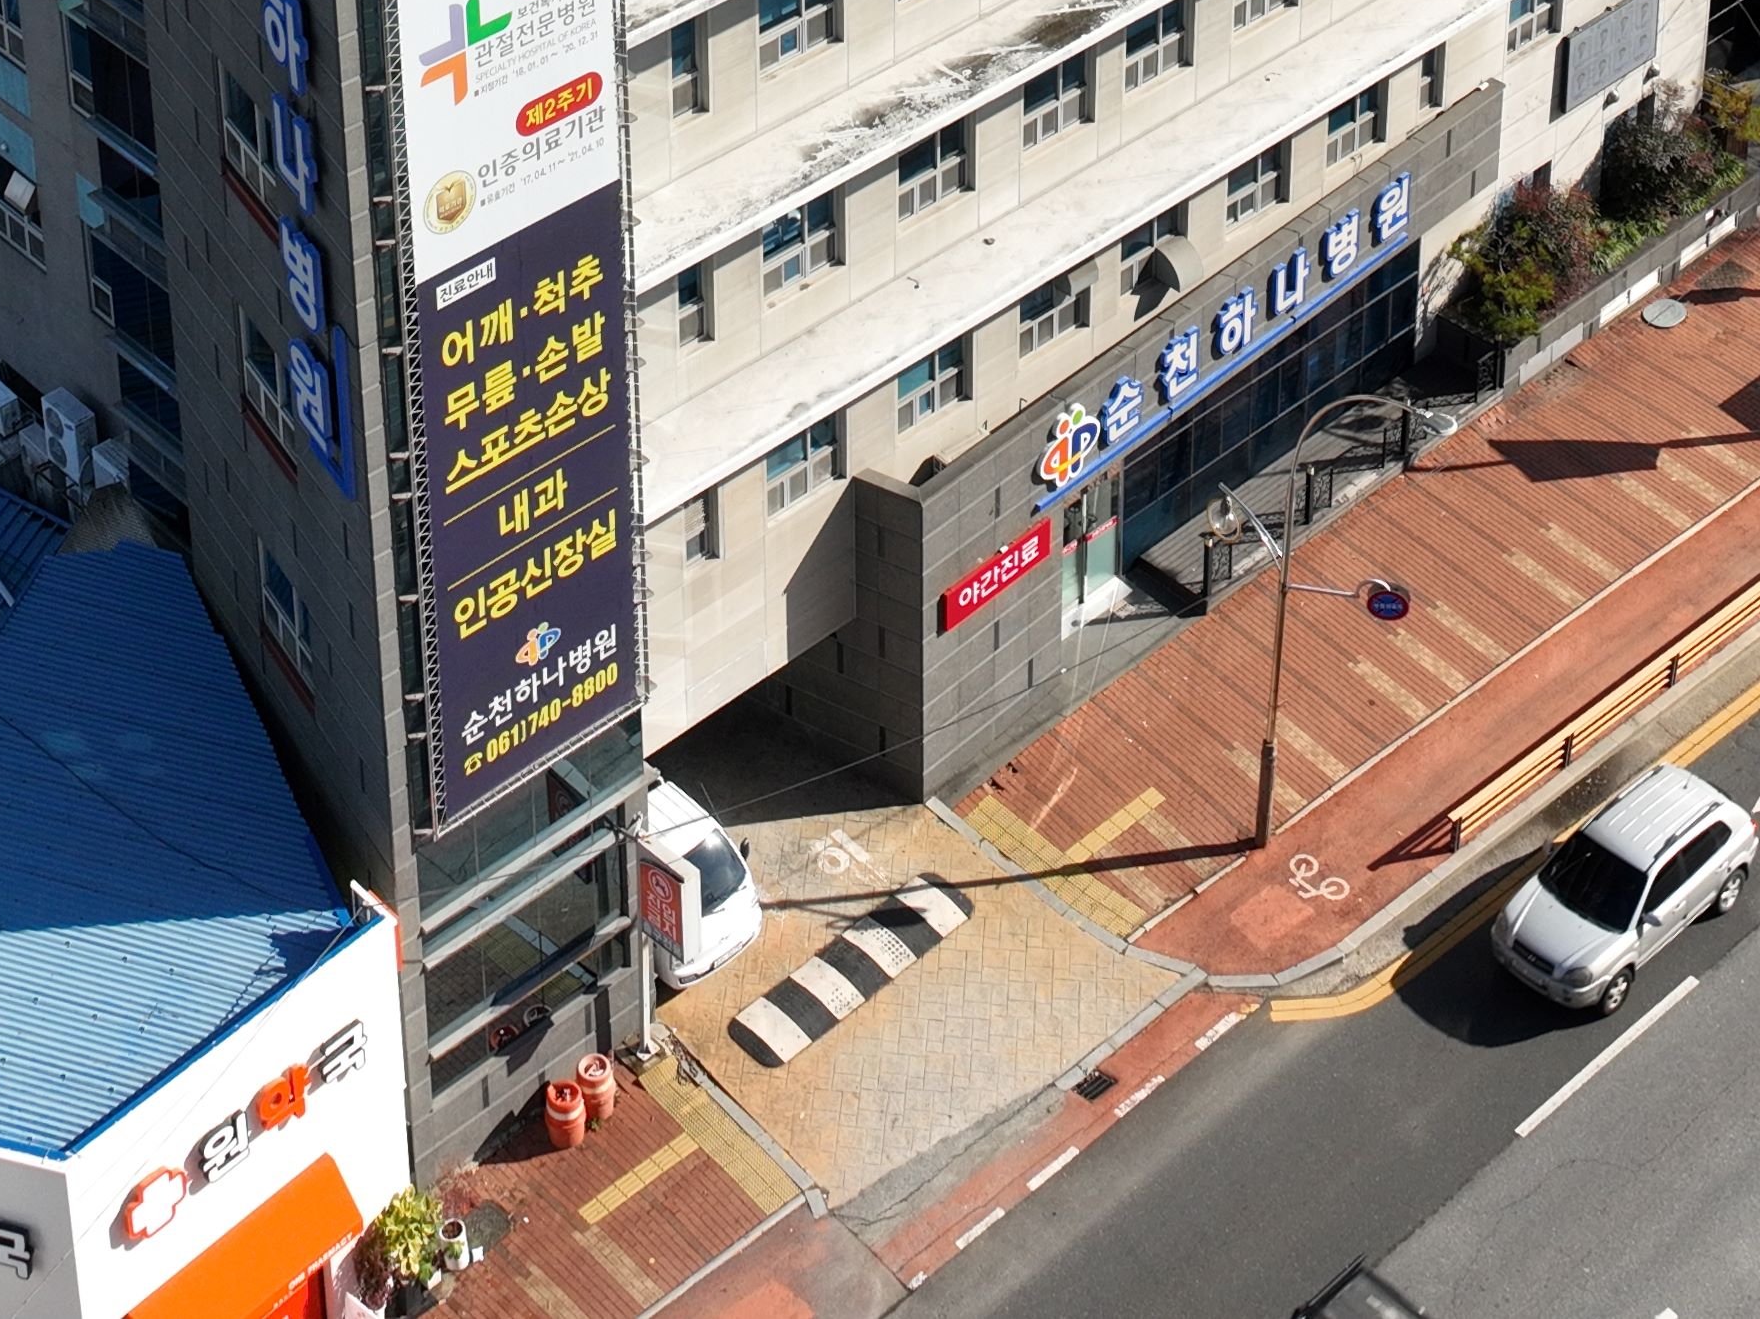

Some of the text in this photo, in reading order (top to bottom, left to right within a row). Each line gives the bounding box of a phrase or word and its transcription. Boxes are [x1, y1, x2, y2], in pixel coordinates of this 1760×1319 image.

[475, 18, 597, 83] SPECIALTY HOSPITAL OF KOREA
[478, 105, 606, 189] 인증의료기관
[526, 77, 593, 128] 제2주기
[439, 262, 493, 304] 진료안내
[442, 254, 603, 367] 어깨·척추
[1102, 172, 1411, 445] 순천하나병원
[444, 310, 606, 431] 무릎·손발
[445, 367, 611, 495] 스포츠손상
[498, 468, 568, 537] 내과
[454, 509, 617, 640] 인공신장실
[958, 532, 1040, 610] 야간진료
[462, 623, 617, 746] 순천하나병원
[486, 662, 618, 764] 061)740-8800
[198, 1018, 369, 1186] 원약국
[307, 1230, 354, 1276] PHARMACY
